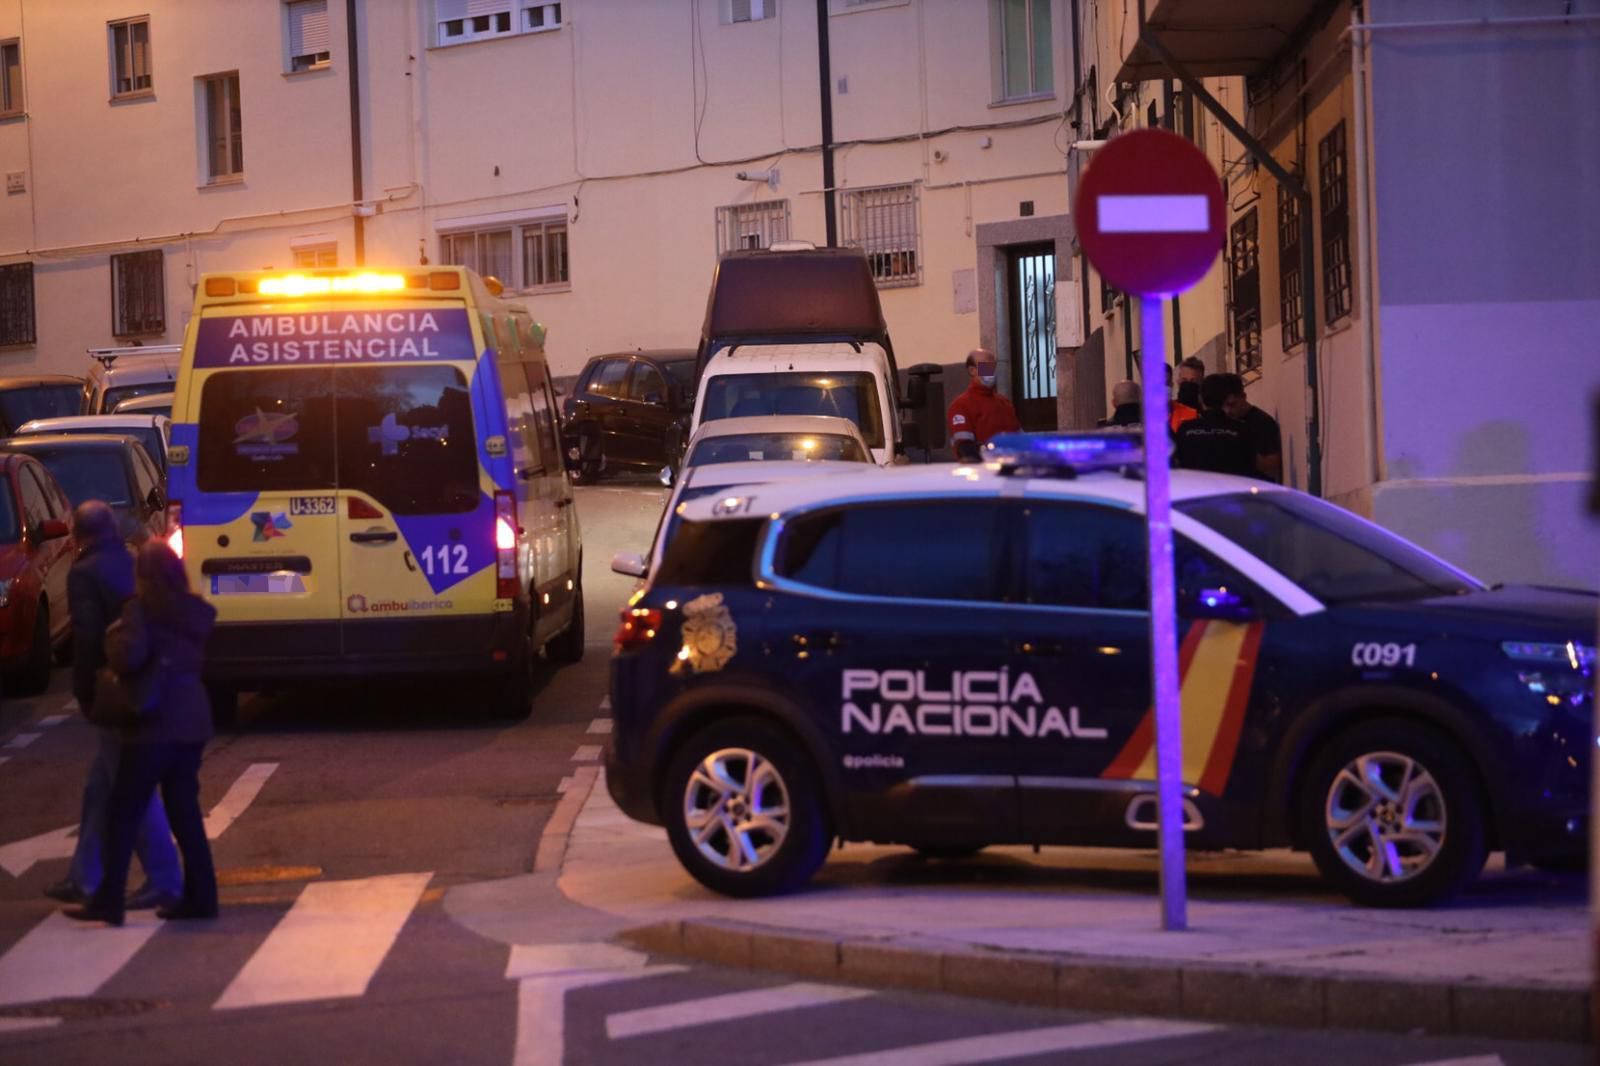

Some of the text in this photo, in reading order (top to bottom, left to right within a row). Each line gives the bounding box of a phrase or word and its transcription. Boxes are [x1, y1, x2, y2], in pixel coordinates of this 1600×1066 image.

[229, 312, 439, 338] AMBULANCIA
[229, 337, 438, 363] ASISTENCIAL
[291, 497, 336, 515] U-3362
[421, 544, 470, 575] 112
[841, 666, 1043, 704] POLICÍA
[841, 702, 1109, 739] NACIONAL
